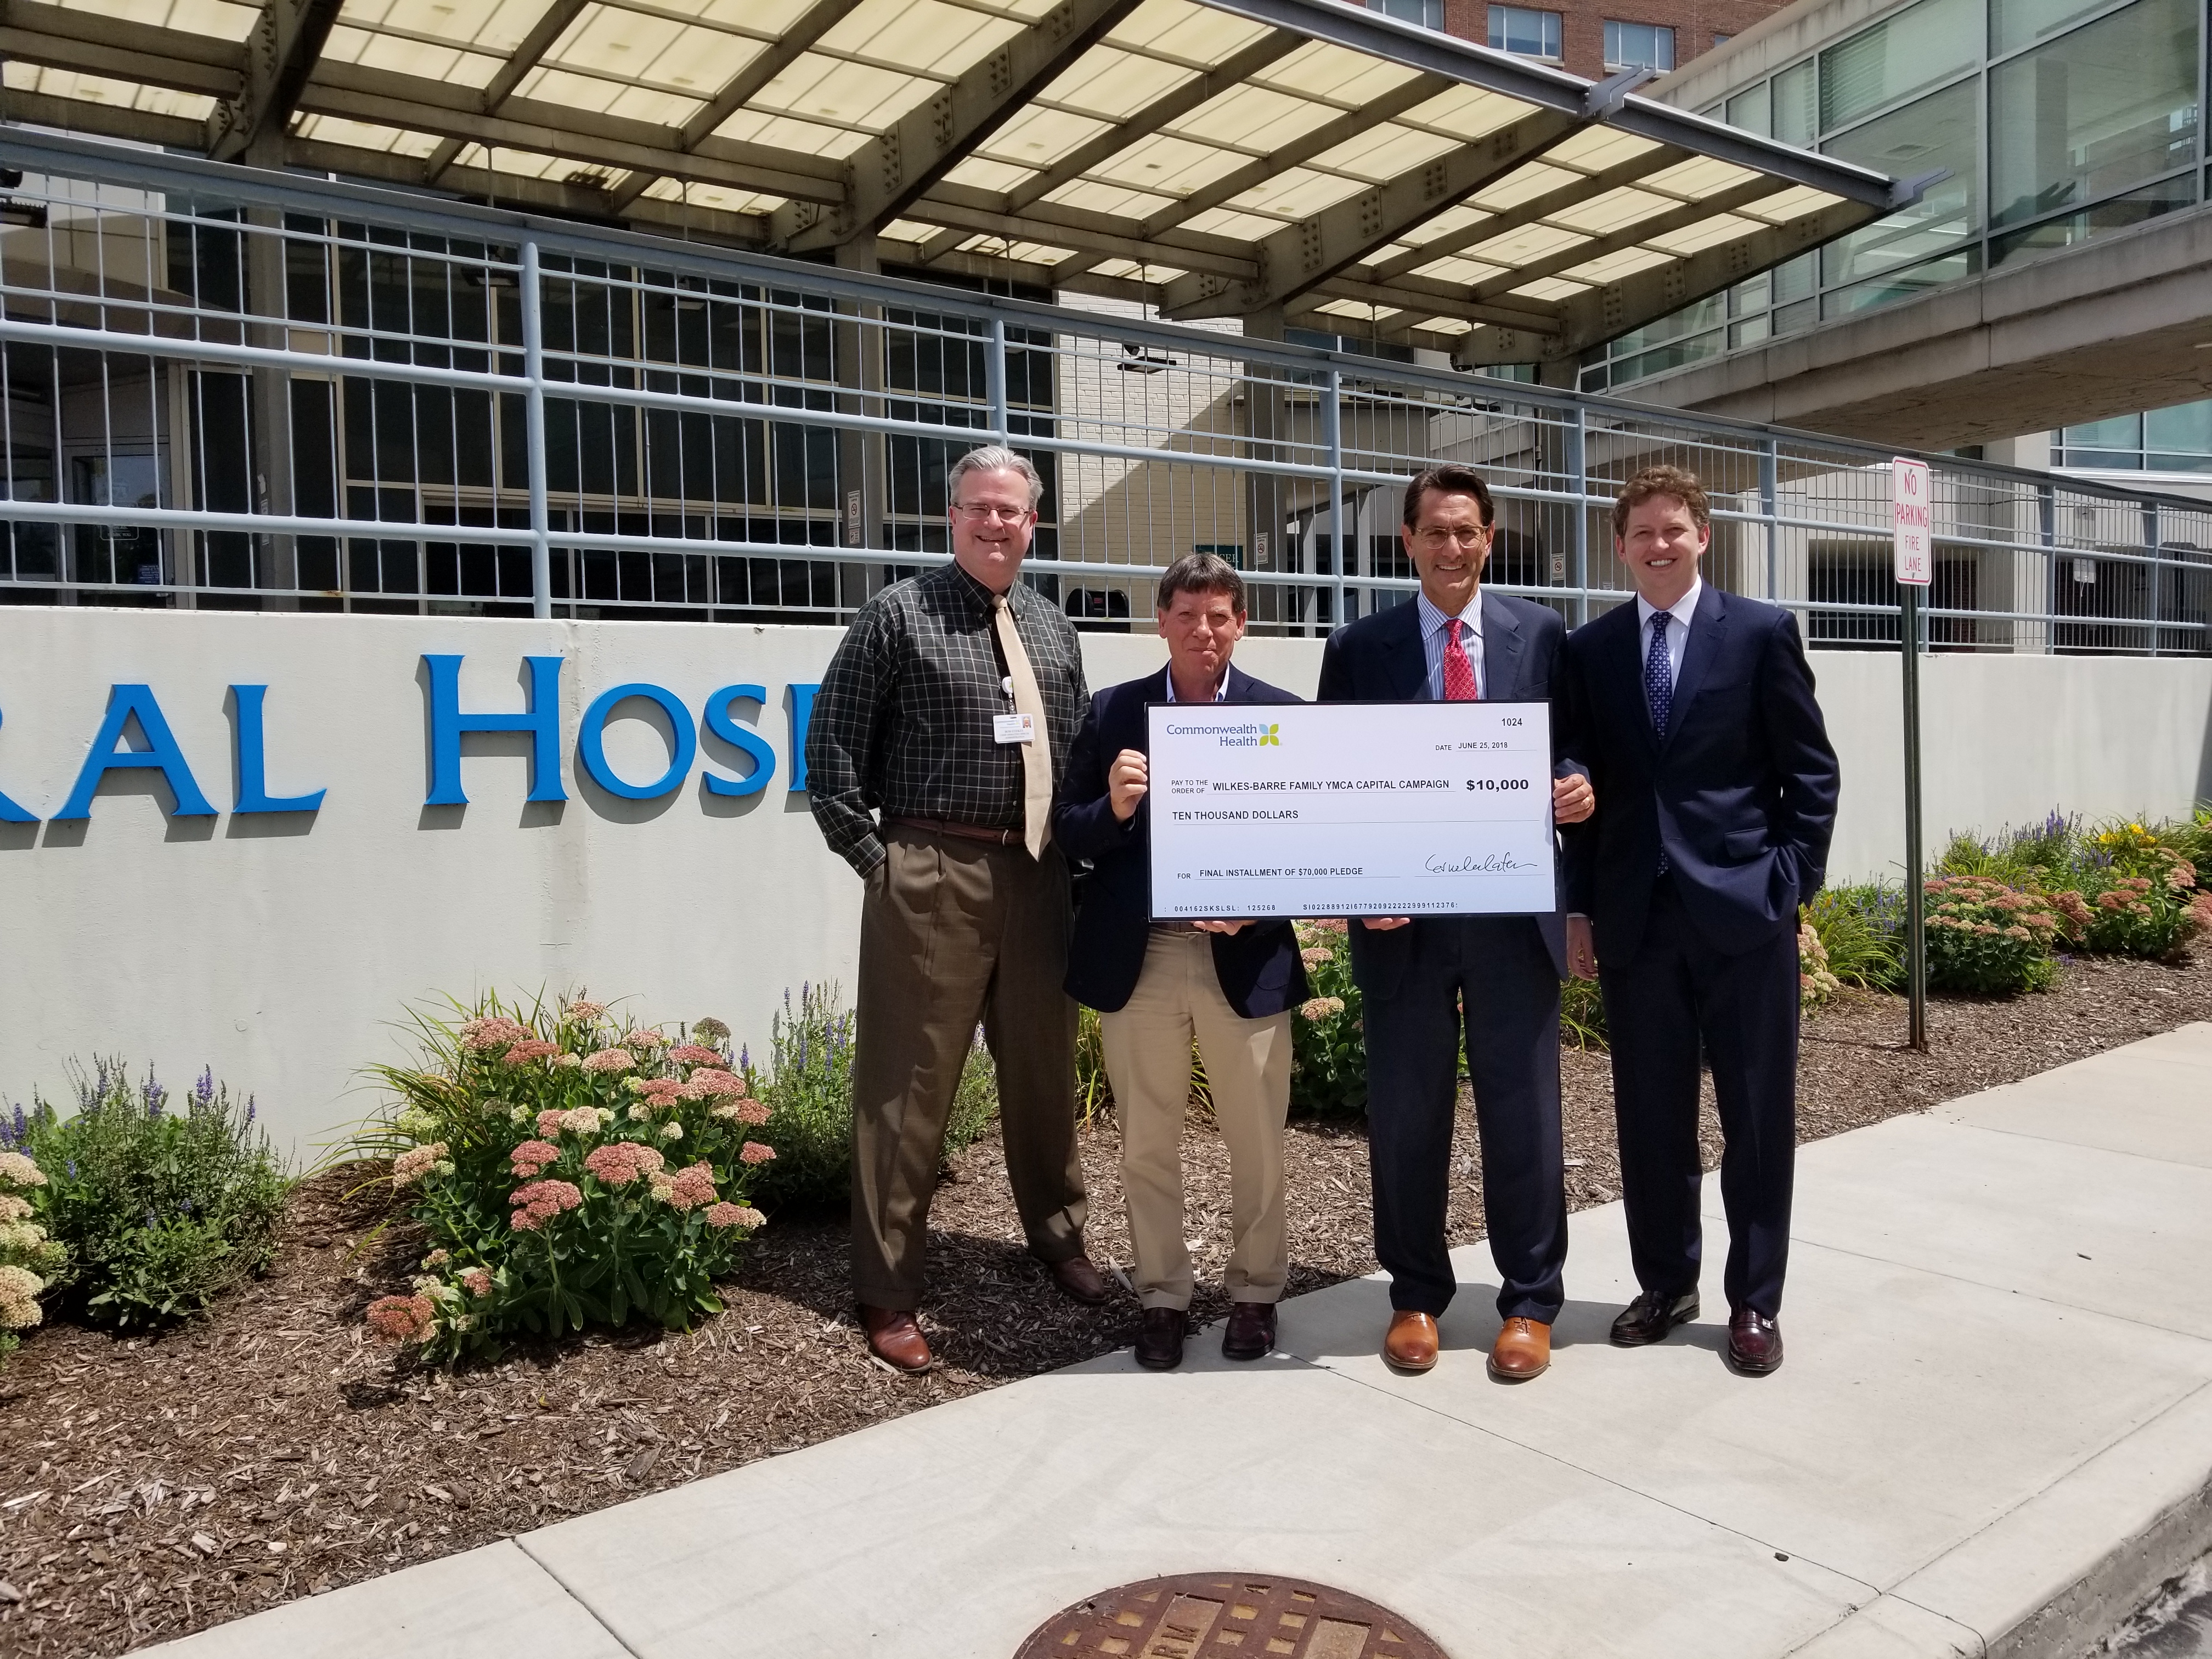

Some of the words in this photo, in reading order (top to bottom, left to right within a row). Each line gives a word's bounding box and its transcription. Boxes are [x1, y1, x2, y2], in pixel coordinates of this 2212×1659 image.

[1904, 472, 1917, 495] NO
[1896, 502, 1927, 528] PARKING
[1905, 535, 1920, 551] FIRE
[1904, 555, 1922, 572] LANE
[1501, 718, 1523, 726] 1024
[1166, 724, 1257, 735] Commonwealth
[1219, 736, 1258, 747] Health
[1479, 742, 1489, 750] 25,
[0, 684, 328, 824] AL
[1212, 781, 1286, 791] WILKES-BARRE
[1289, 781, 1323, 790] FAMILY
[1325, 781, 1354, 790] YMCA
[1356, 780, 1396, 789] CAPITAL
[1398, 779, 1449, 789] CAMPAIGN
[1466, 779, 1530, 793] $10,000
[1172, 811, 1192, 820] TEN
[1194, 810, 1249, 820] THOUSAND
[1252, 810, 1299, 819] DOLLARS
[1200, 869, 1224, 877] FINAL
[1226, 868, 1283, 877] INSTALLMENT
[1285, 868, 1296, 876] OF
[1298, 867, 1328, 877] $70,000
[1330, 867, 1363, 876] PLEDGE
